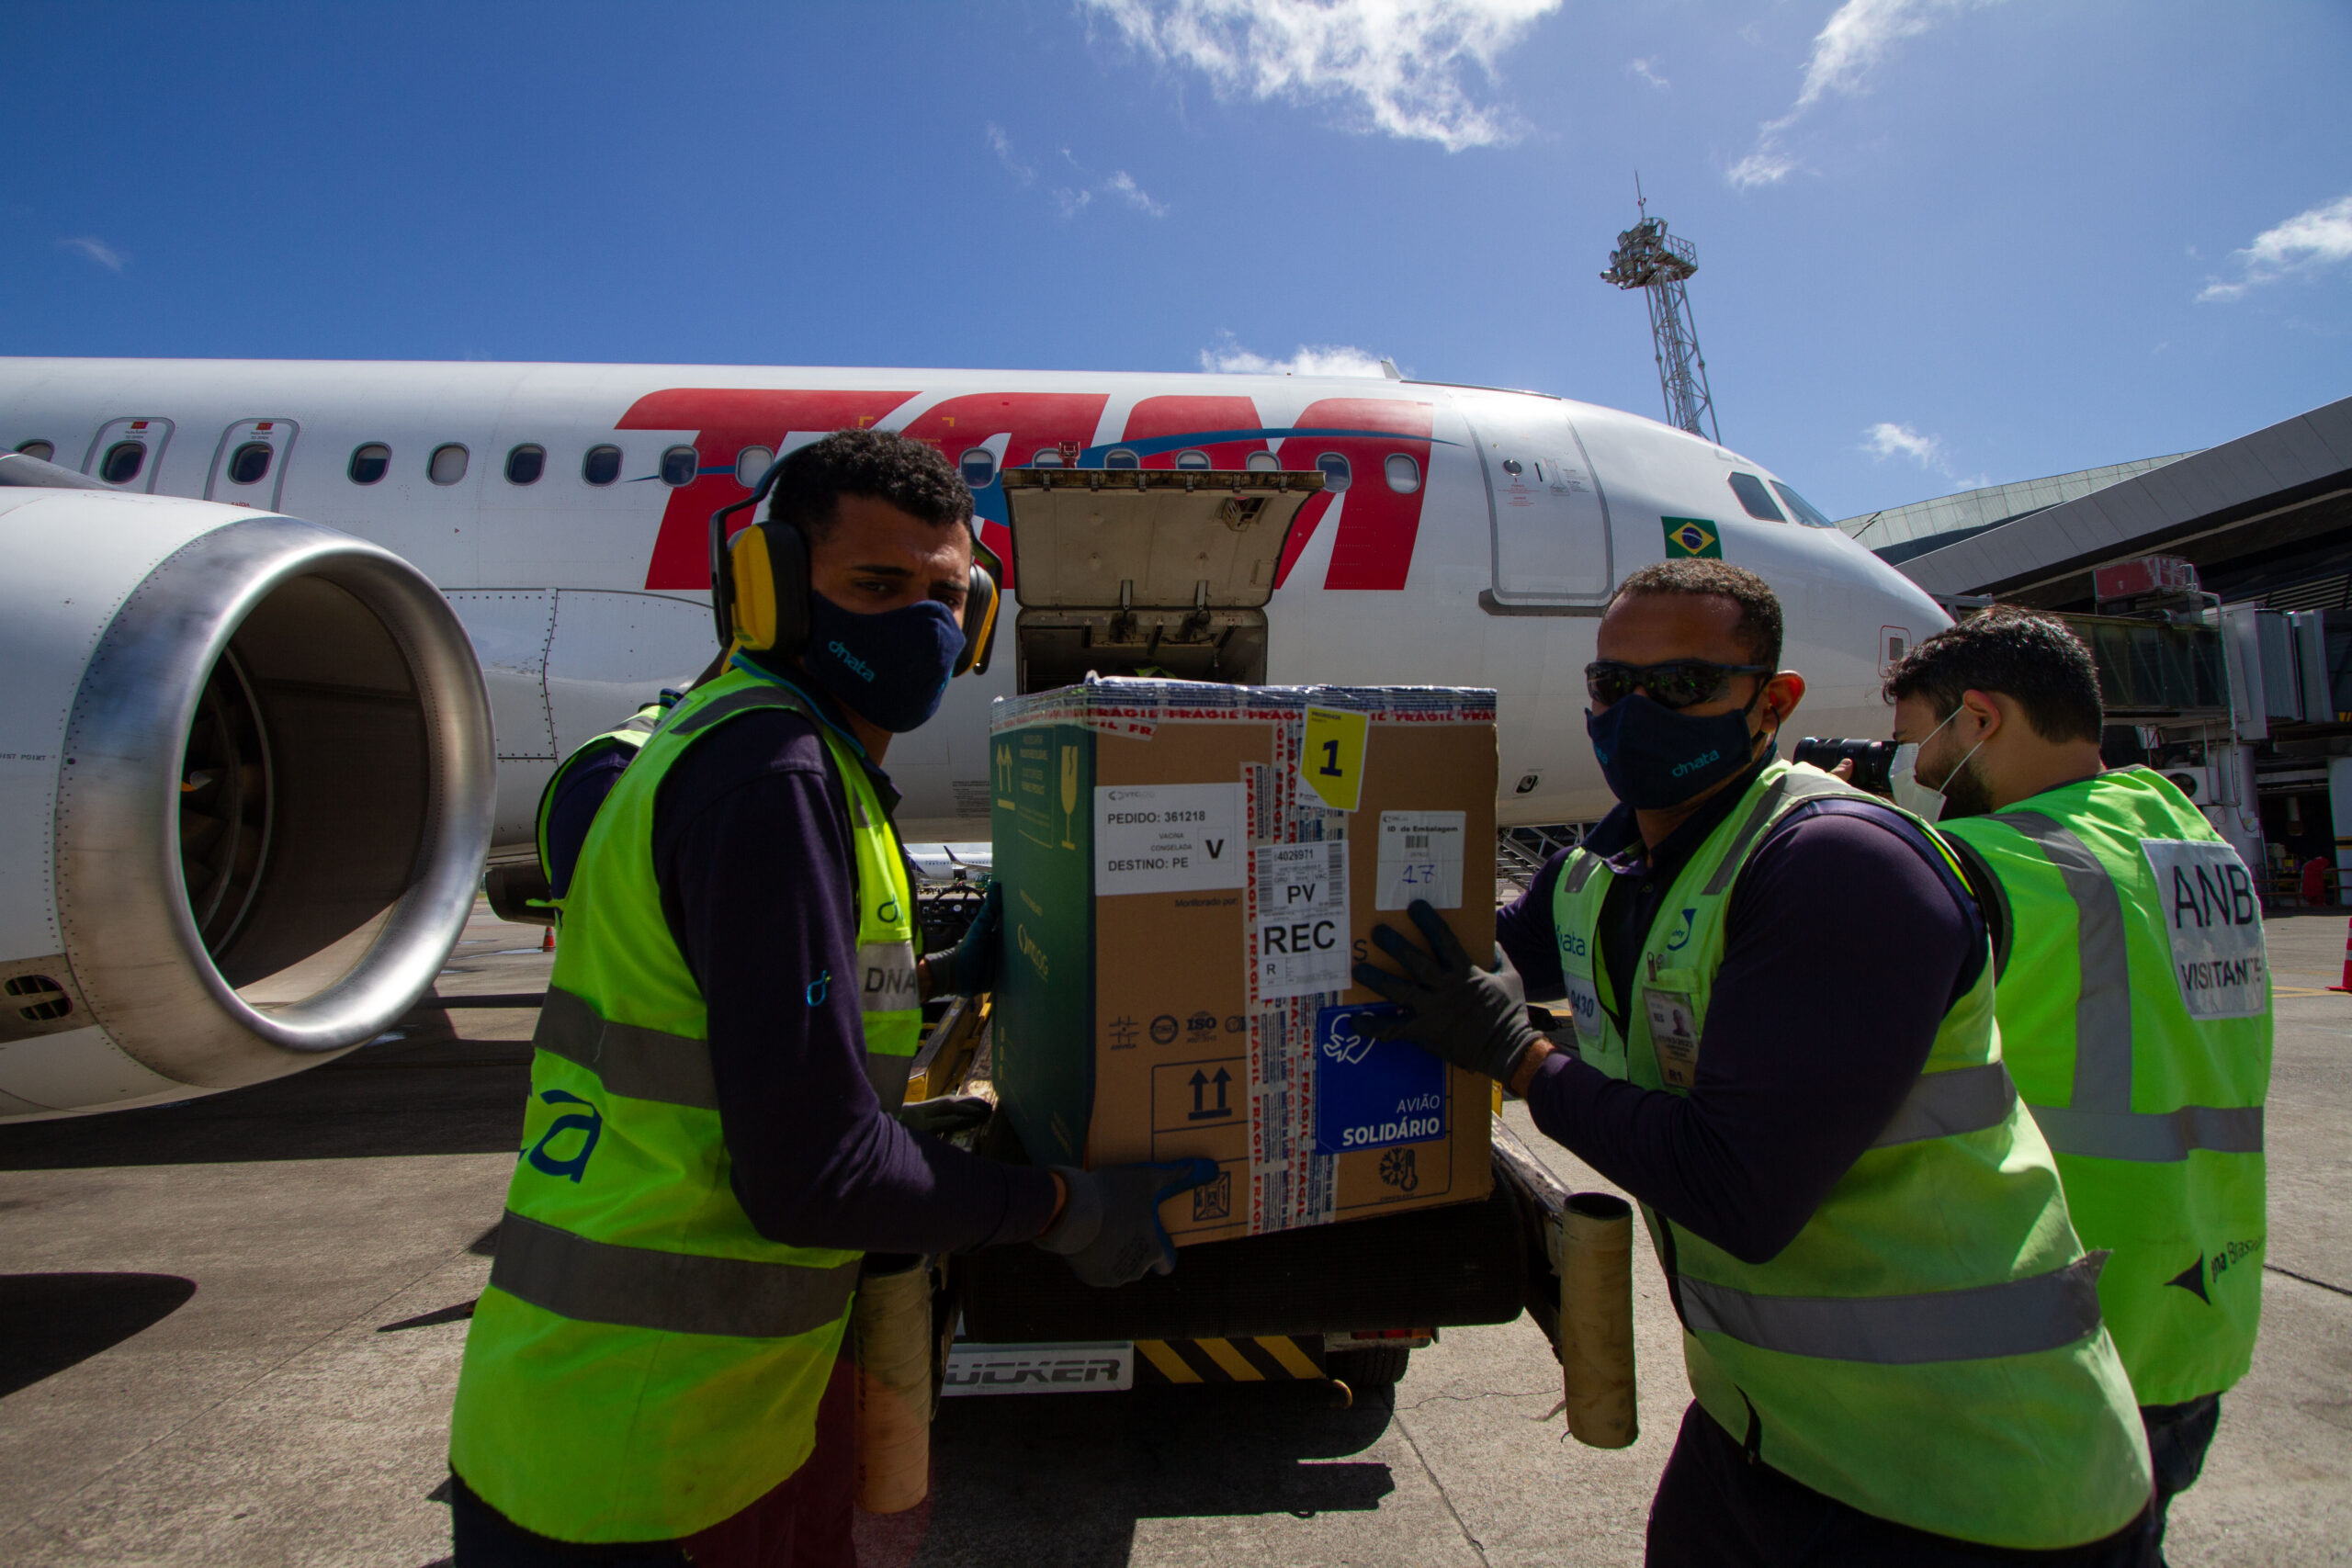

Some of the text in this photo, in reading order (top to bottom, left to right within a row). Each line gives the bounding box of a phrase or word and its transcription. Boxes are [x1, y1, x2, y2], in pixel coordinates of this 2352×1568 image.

[828, 639, 875, 682] dnata
[1319, 739, 1342, 777] 1
[1671, 749, 1721, 778] dnata
[1108, 810, 1205, 824] PEDIDO: 361218
[1205, 839, 1225, 859] V
[1108, 857, 1189, 872] DESTINO: PE
[1287, 883, 1316, 904] PV
[2174, 864, 2255, 929] ANB
[1264, 920, 1335, 955] REC
[1267, 964, 1276, 975] R
[1186, 1016, 1217, 1031] ISO
[1396, 1092, 1441, 1114] AVIÃO
[1342, 1115, 1441, 1147] SOLIDÁRIO
